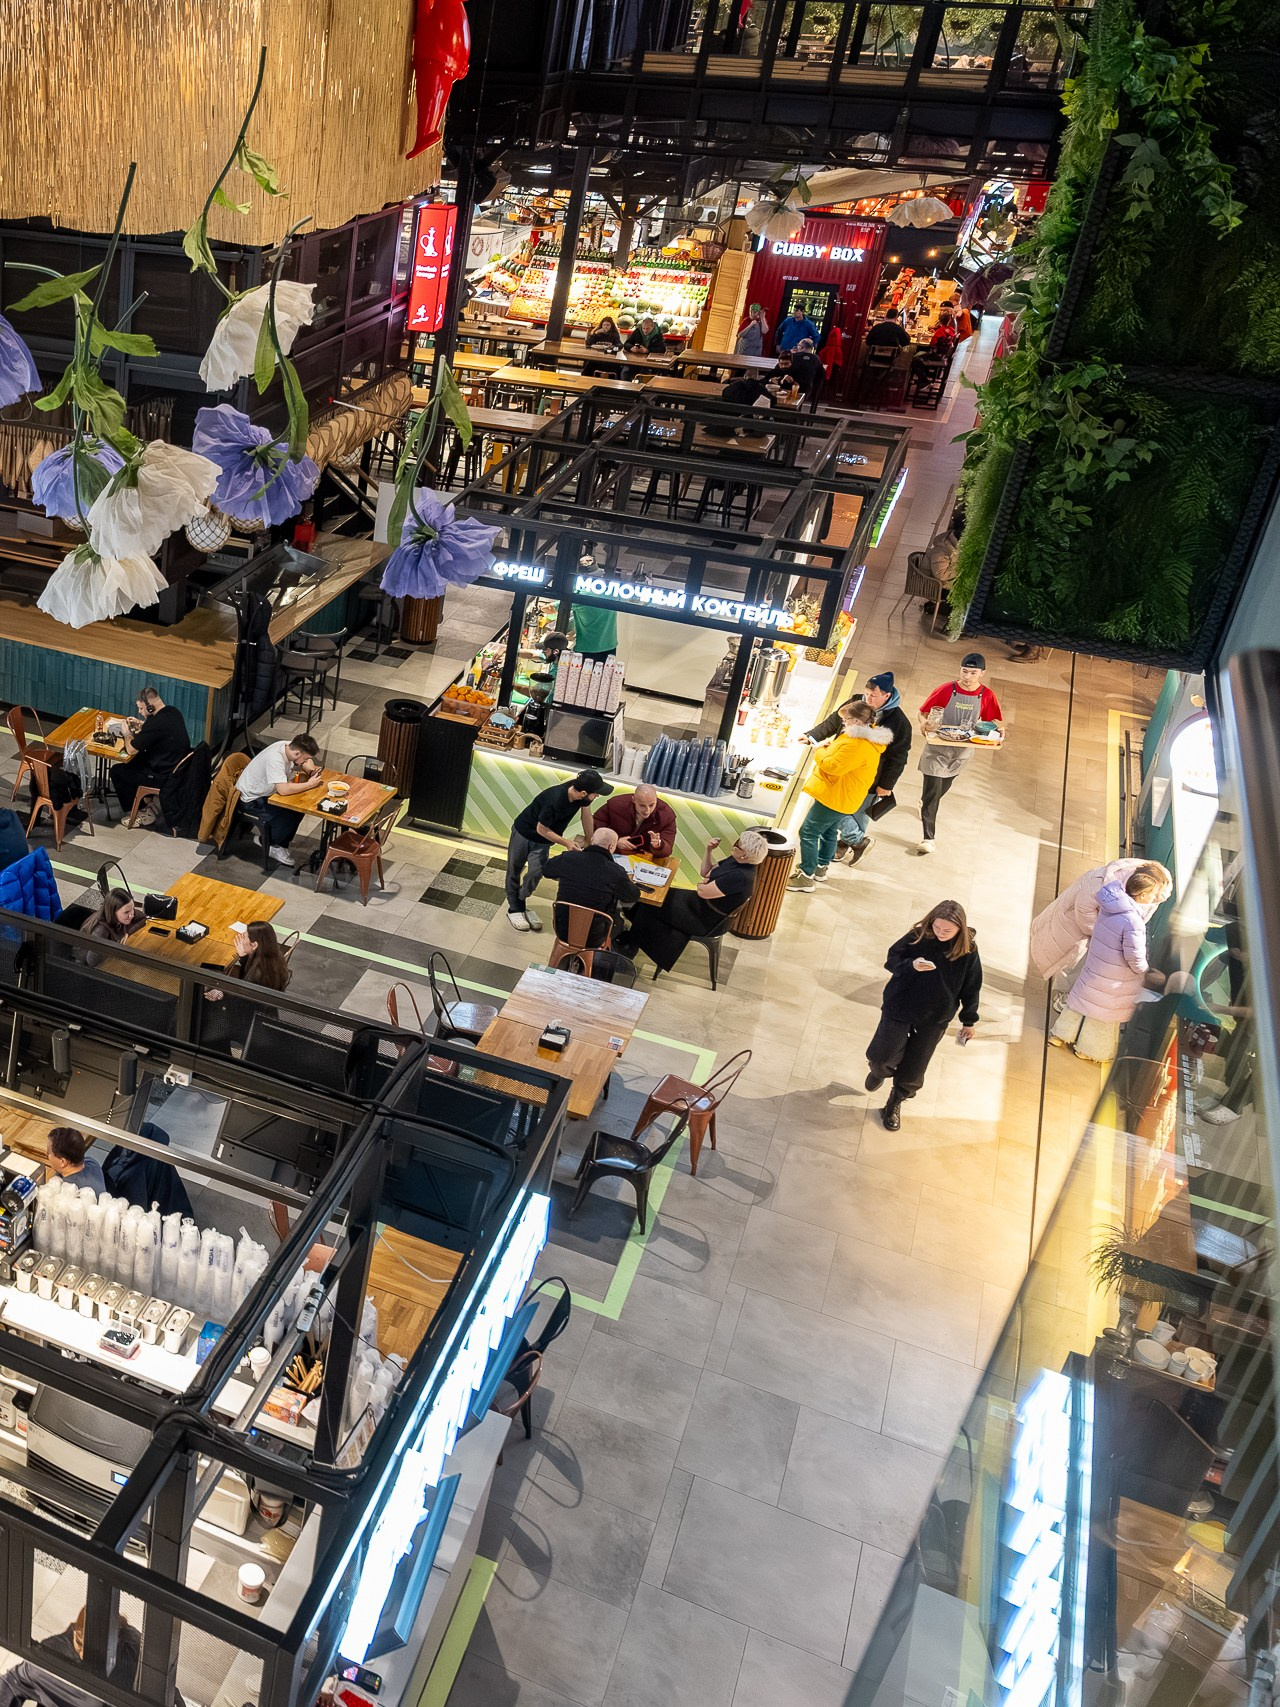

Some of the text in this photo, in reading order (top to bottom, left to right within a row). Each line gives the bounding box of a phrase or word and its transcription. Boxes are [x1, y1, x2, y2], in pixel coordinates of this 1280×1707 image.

[772, 241, 865, 262] CUBBY BOX
[493, 561, 794, 628] ФРЕШ МОЛОЧНЫЙ КОКТЕЙЛЬ
